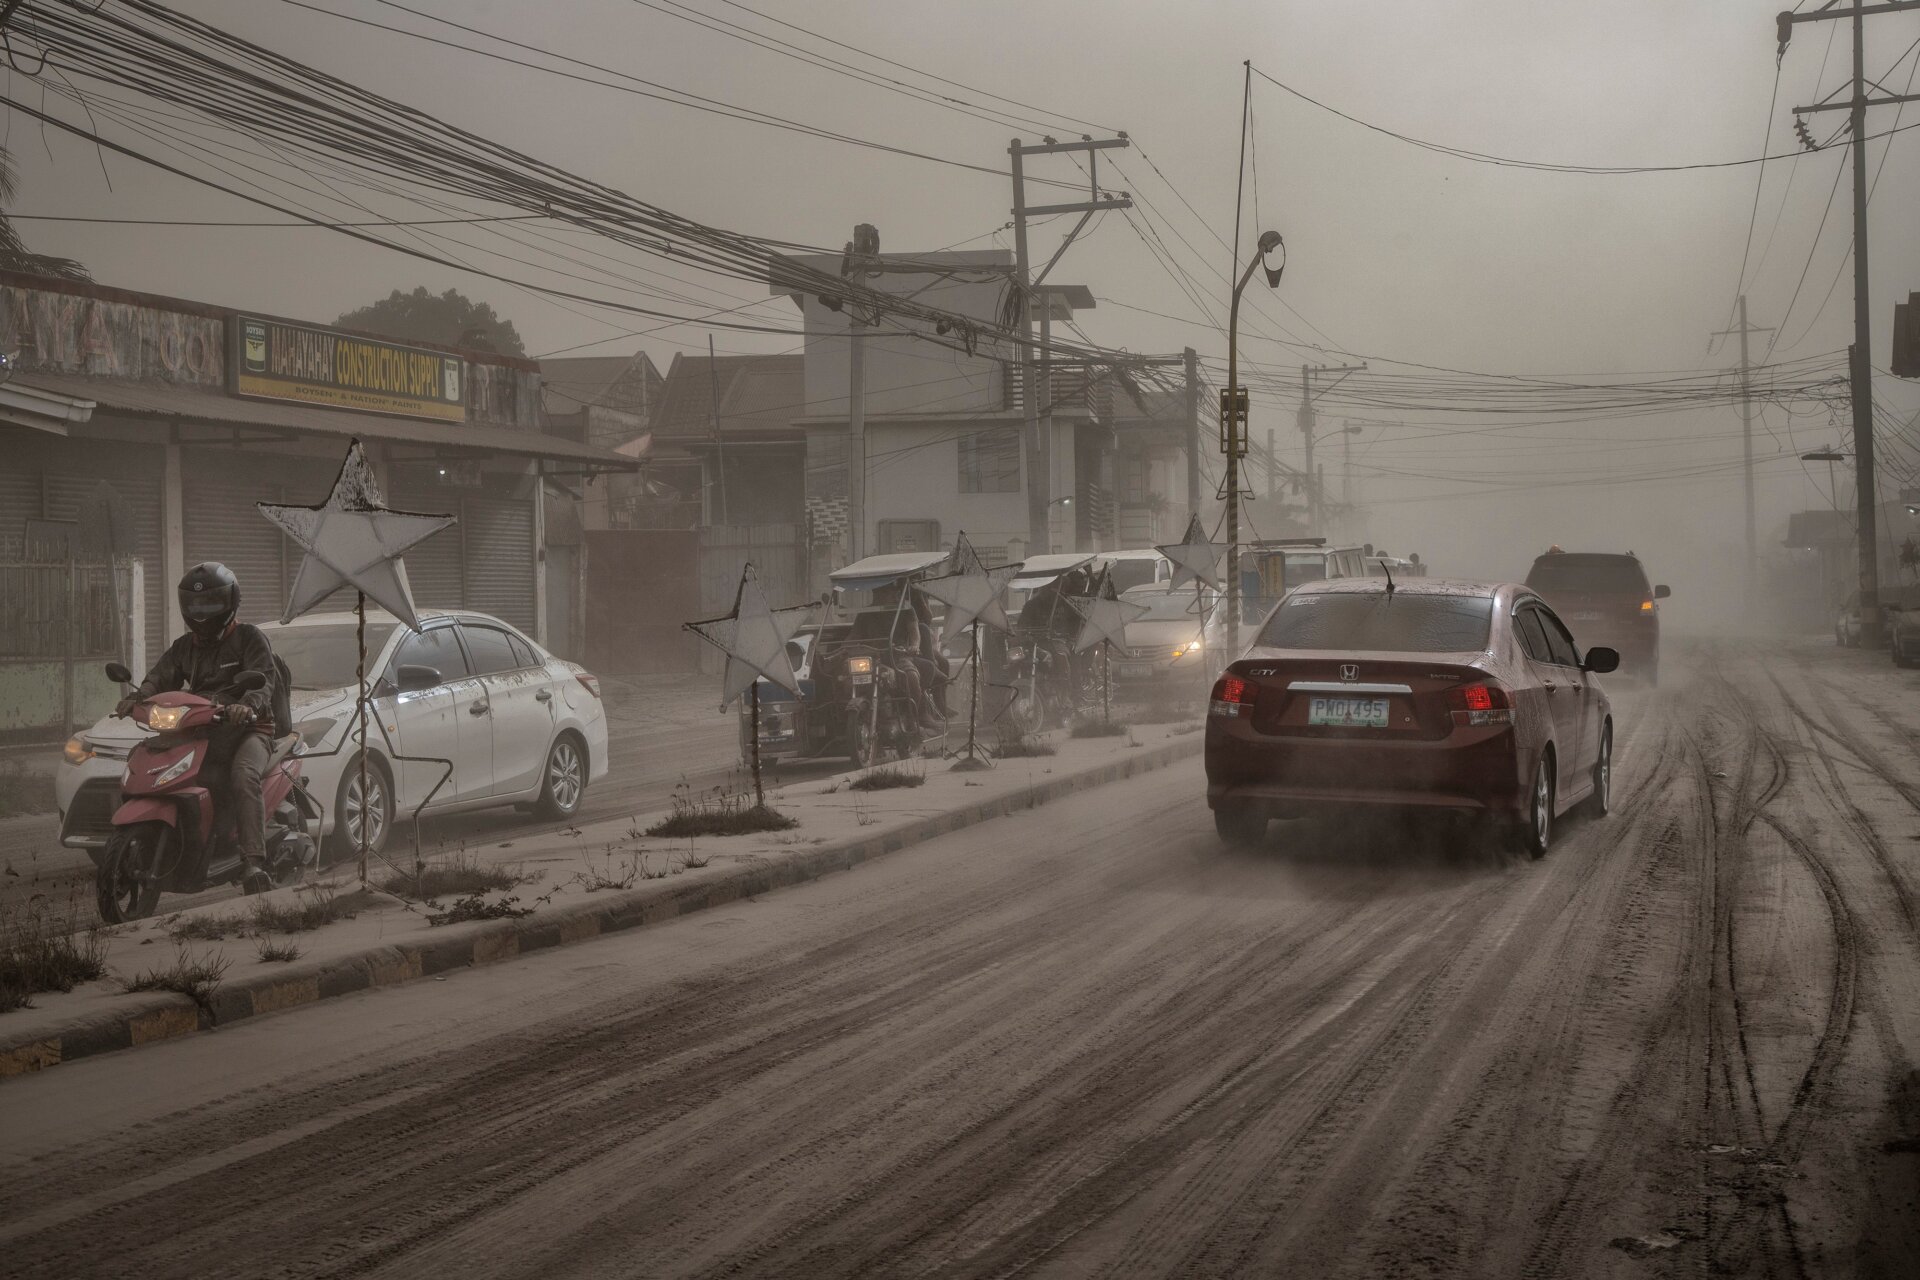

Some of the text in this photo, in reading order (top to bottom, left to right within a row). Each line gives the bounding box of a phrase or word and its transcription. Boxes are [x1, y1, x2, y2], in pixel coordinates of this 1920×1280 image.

[271, 326, 335, 382] MAHAYAHAY
[337, 339, 408, 393] CONSTRUCTION
[409, 352, 440, 398] SUPPLY
[392, 400, 422, 410] PAINTS
[1249, 668, 1277, 676] CITY
[1352, 702, 1382, 719] 495
